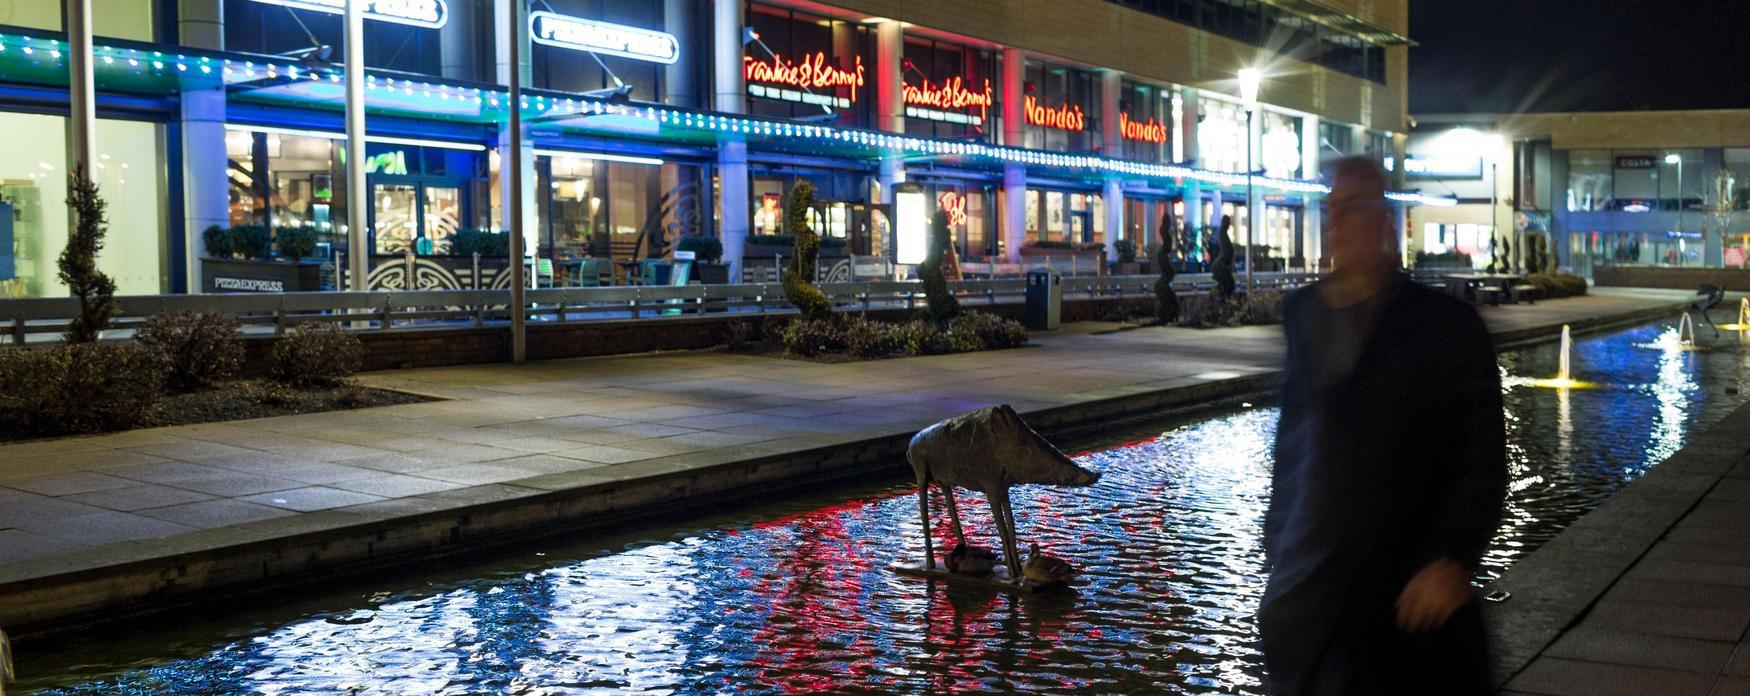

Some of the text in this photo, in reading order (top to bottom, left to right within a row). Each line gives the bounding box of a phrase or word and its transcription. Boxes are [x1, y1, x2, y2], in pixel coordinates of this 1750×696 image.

[799, 53, 812, 87] &
[813, 51, 864, 103] Benny's
[942, 77, 953, 108] &
[953, 76, 992, 121] Benny's
[1024, 94, 1084, 131] Nando's
[1120, 111, 1167, 144] Nando's
[214, 277, 284, 292] PIZZAEXPRESS
